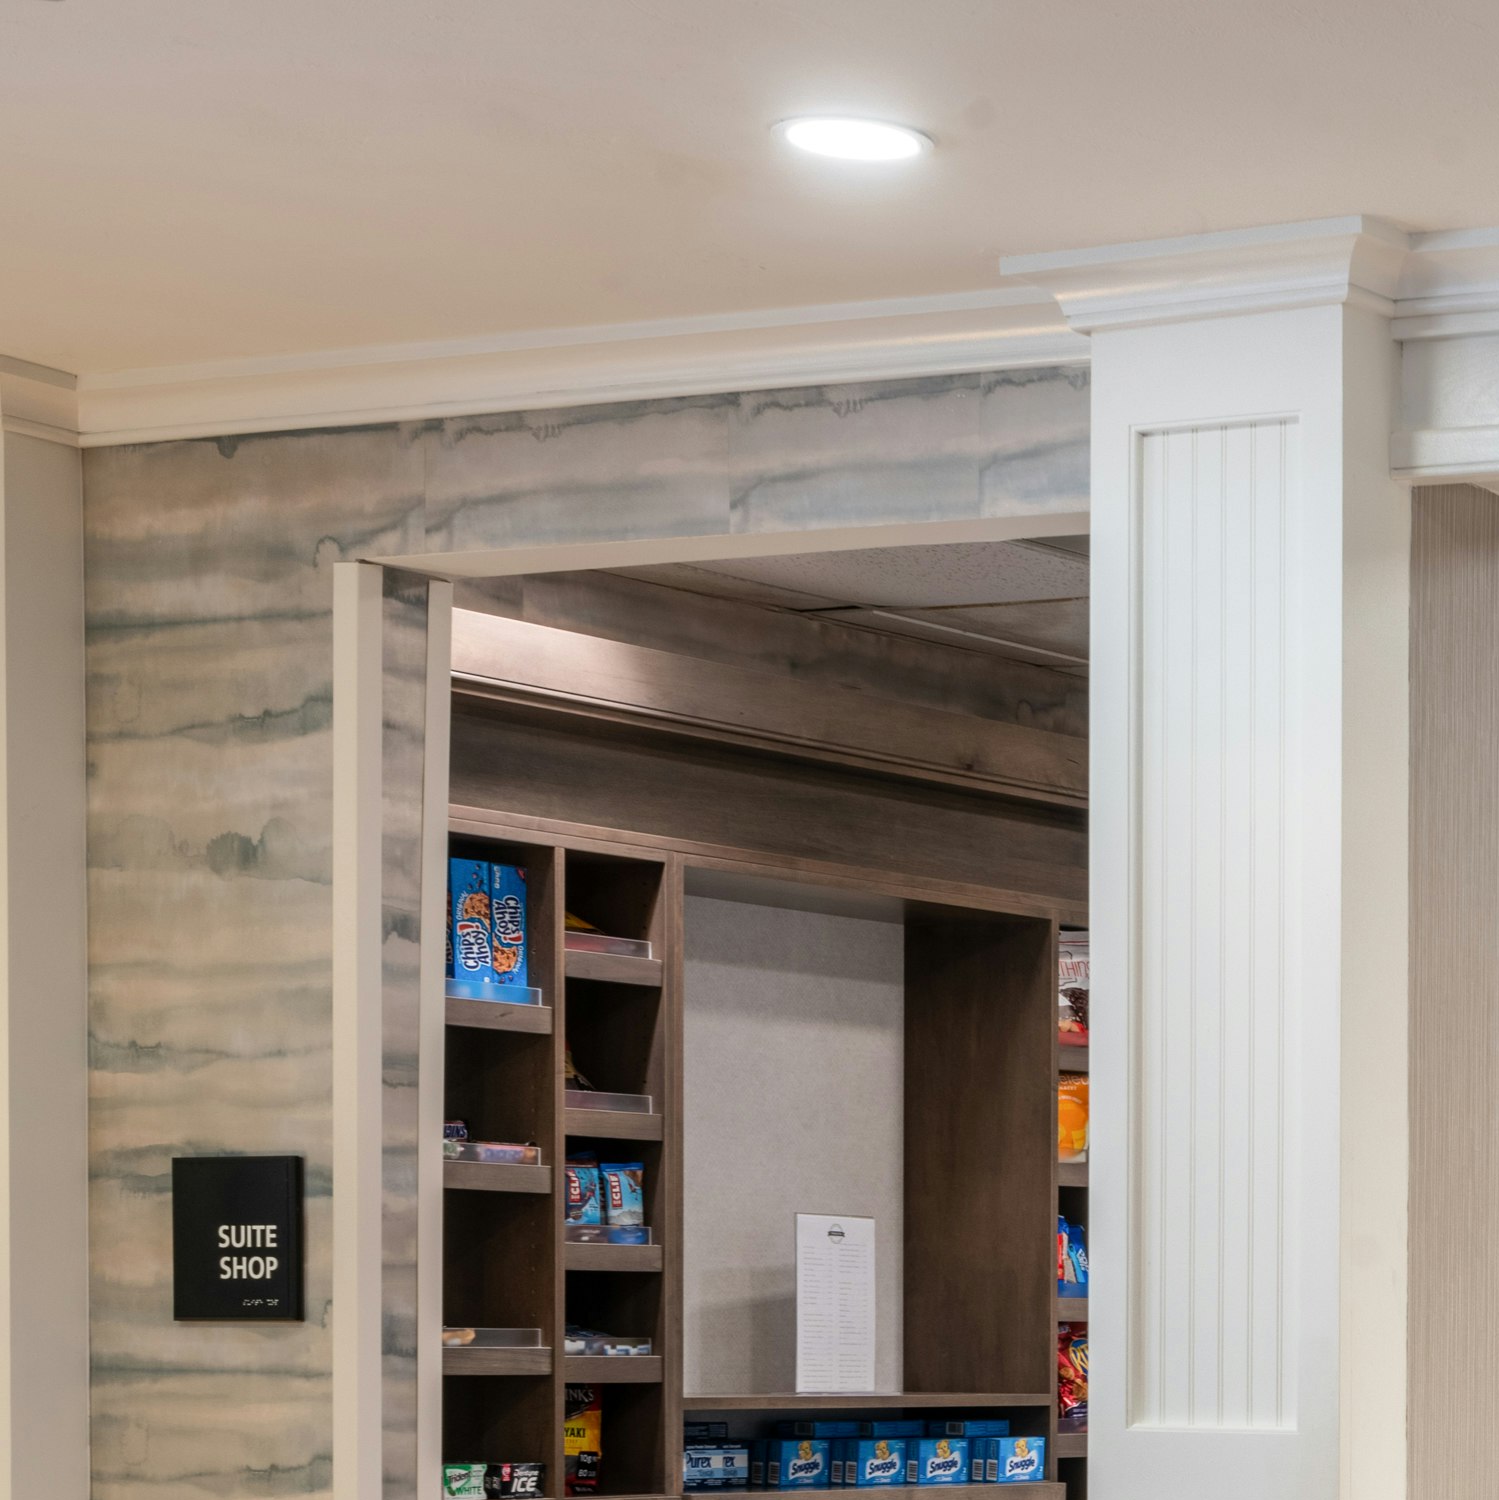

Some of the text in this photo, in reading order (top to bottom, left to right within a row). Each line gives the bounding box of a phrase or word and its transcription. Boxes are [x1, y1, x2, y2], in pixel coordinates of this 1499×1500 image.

[504, 895, 520, 935] Chips
[461, 930, 479, 970] Chips
[609, 1175, 622, 1201] CLIF
[218, 1225, 278, 1249] SUITE
[219, 1256, 279, 1280] SHOP
[791, 1460, 821, 1476] Snuggle
[868, 1459, 897, 1475] Snuggle
[929, 1458, 958, 1474] Snuggle
[1008, 1456, 1036, 1473] Snuggle
[455, 1485, 483, 1496] WHITE
[511, 1476, 538, 1493] ICE
